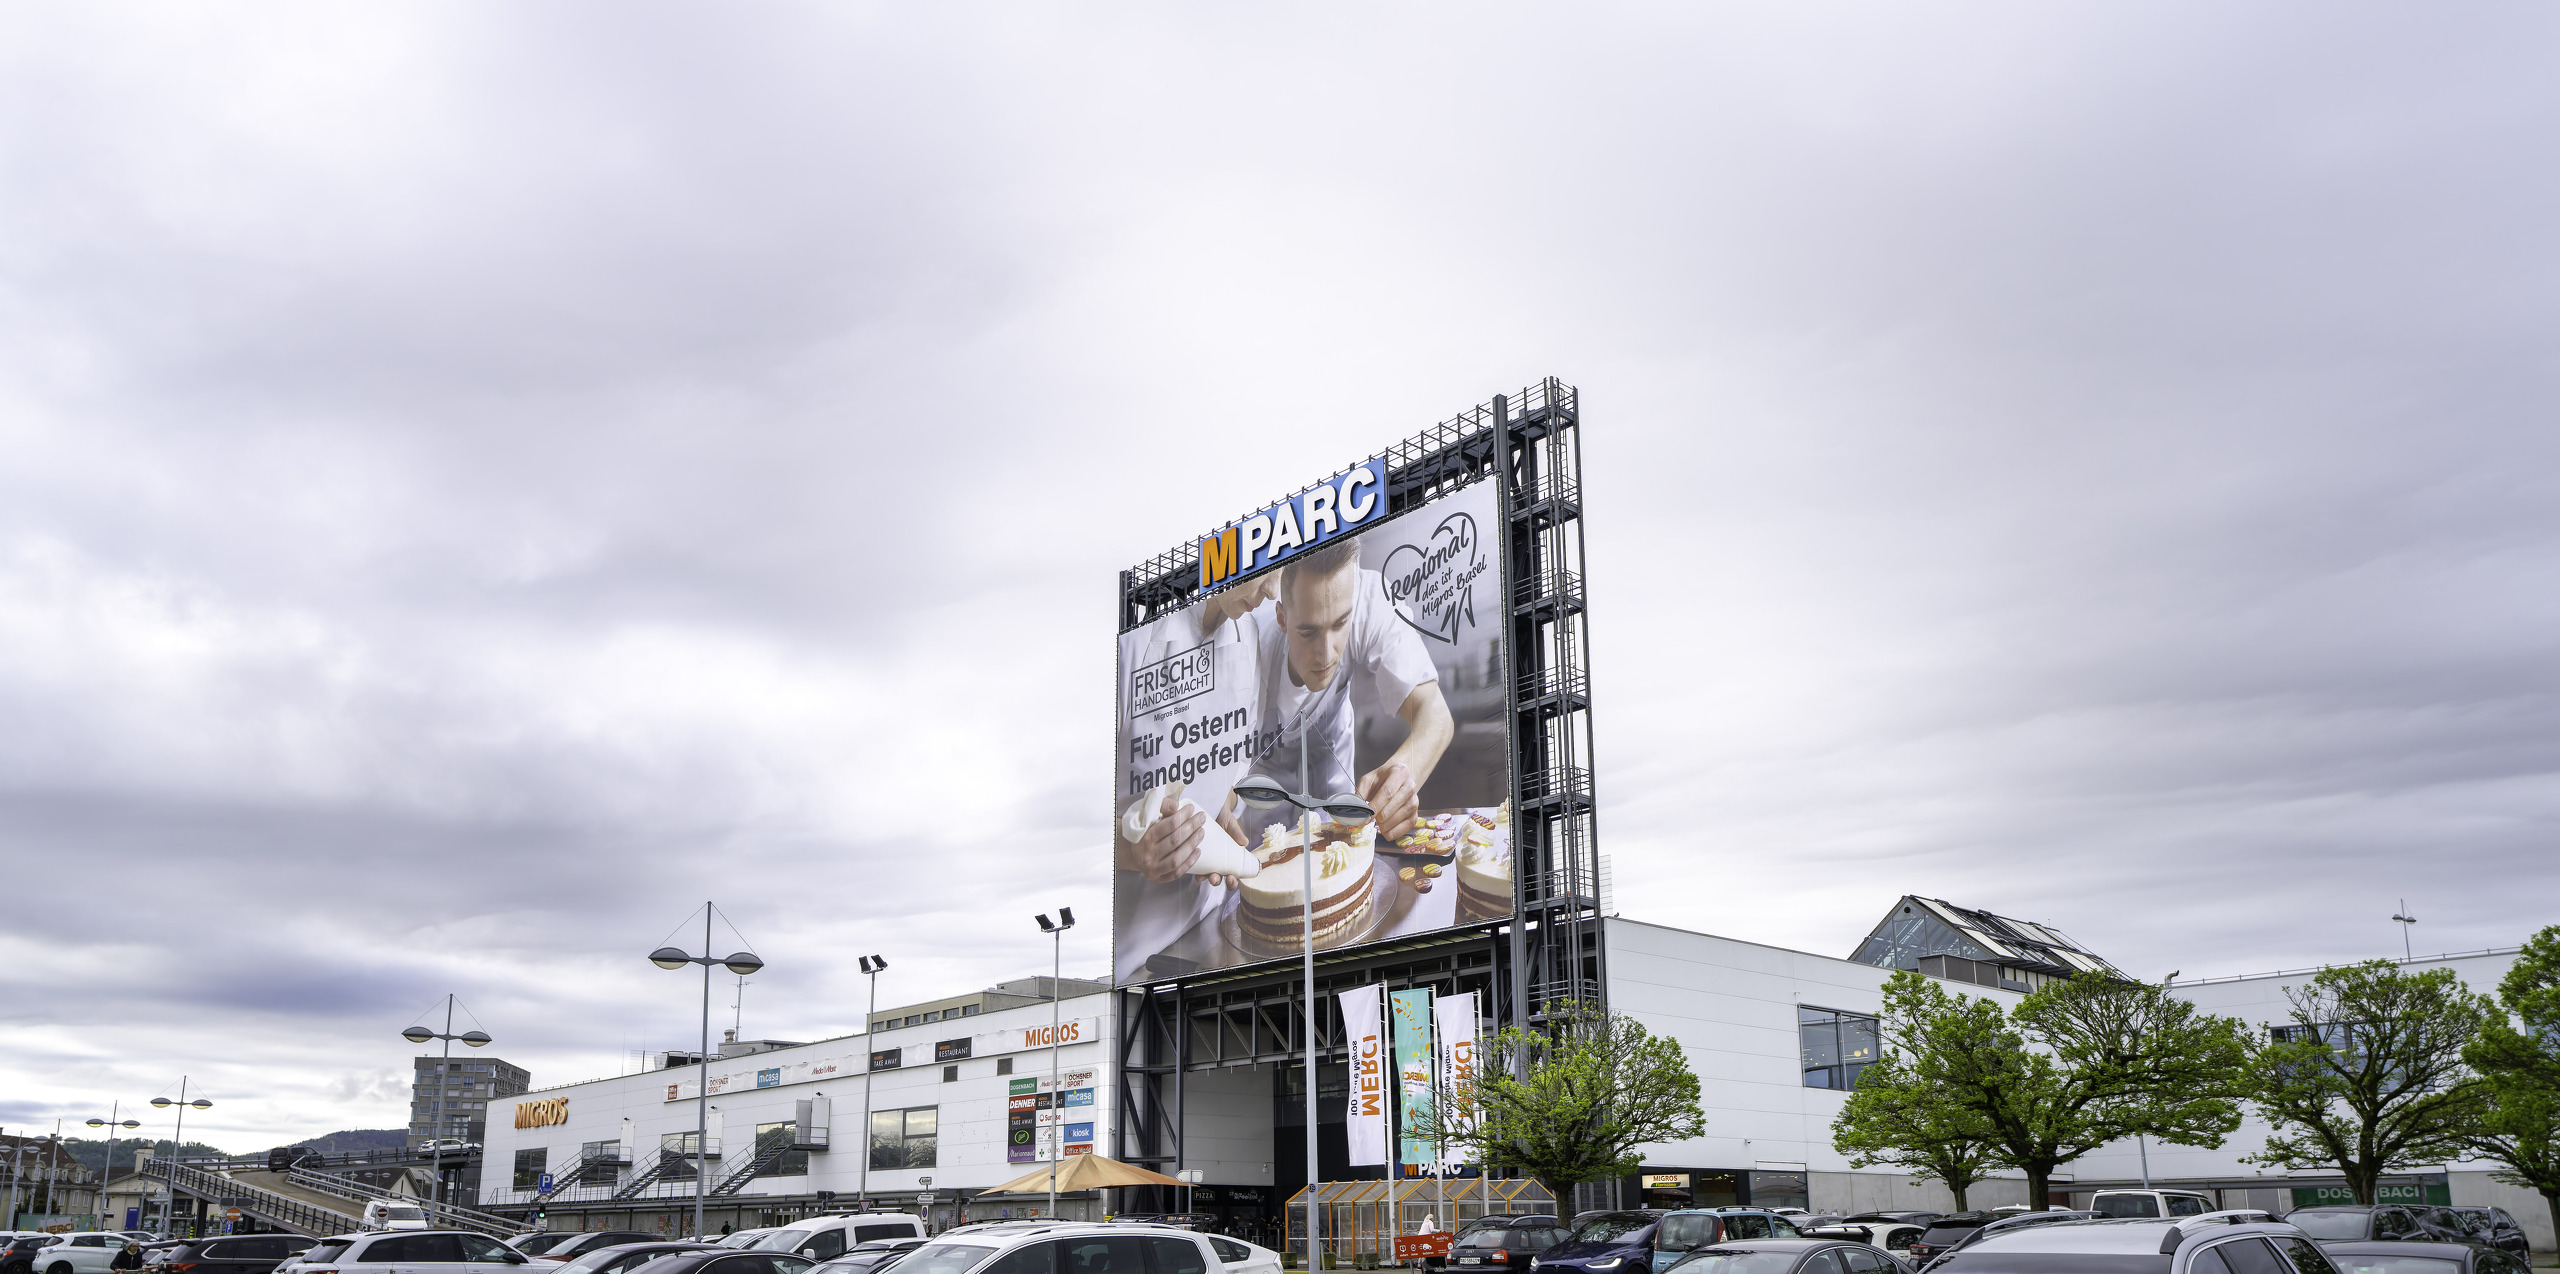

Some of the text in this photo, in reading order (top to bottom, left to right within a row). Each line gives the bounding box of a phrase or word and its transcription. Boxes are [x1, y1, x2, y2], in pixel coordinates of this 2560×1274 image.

[1202, 467, 1377, 588] MPARC
[1390, 519, 1470, 606] Regional
[1422, 567, 1453, 601] das ist
[1423, 554, 1487, 620] Migros Basel
[1135, 648, 1210, 697] FRISCH &
[1135, 673, 1210, 711] HANDGEMACHT
[1154, 703, 1190, 721] Migros Basel
[1130, 706, 1247, 763] Für Ostern
[1130, 723, 1285, 795] handgefertigt
[1025, 1022, 1079, 1047] MIGROS
[938, 1047, 968, 1058] RESTAURANT
[759, 1071, 779, 1083] micasa
[1067, 1080, 1084, 1088] SPORT
[1069, 1072, 1093, 1080] OCHSNER
[1010, 1098, 1036, 1109] DENNER
[1068, 1090, 1092, 1102] micasa
[514, 1096, 569, 1129] MIGROS
[542, 1175, 551, 1187] P
[2317, 1186, 2427, 1199] DOSBAC
